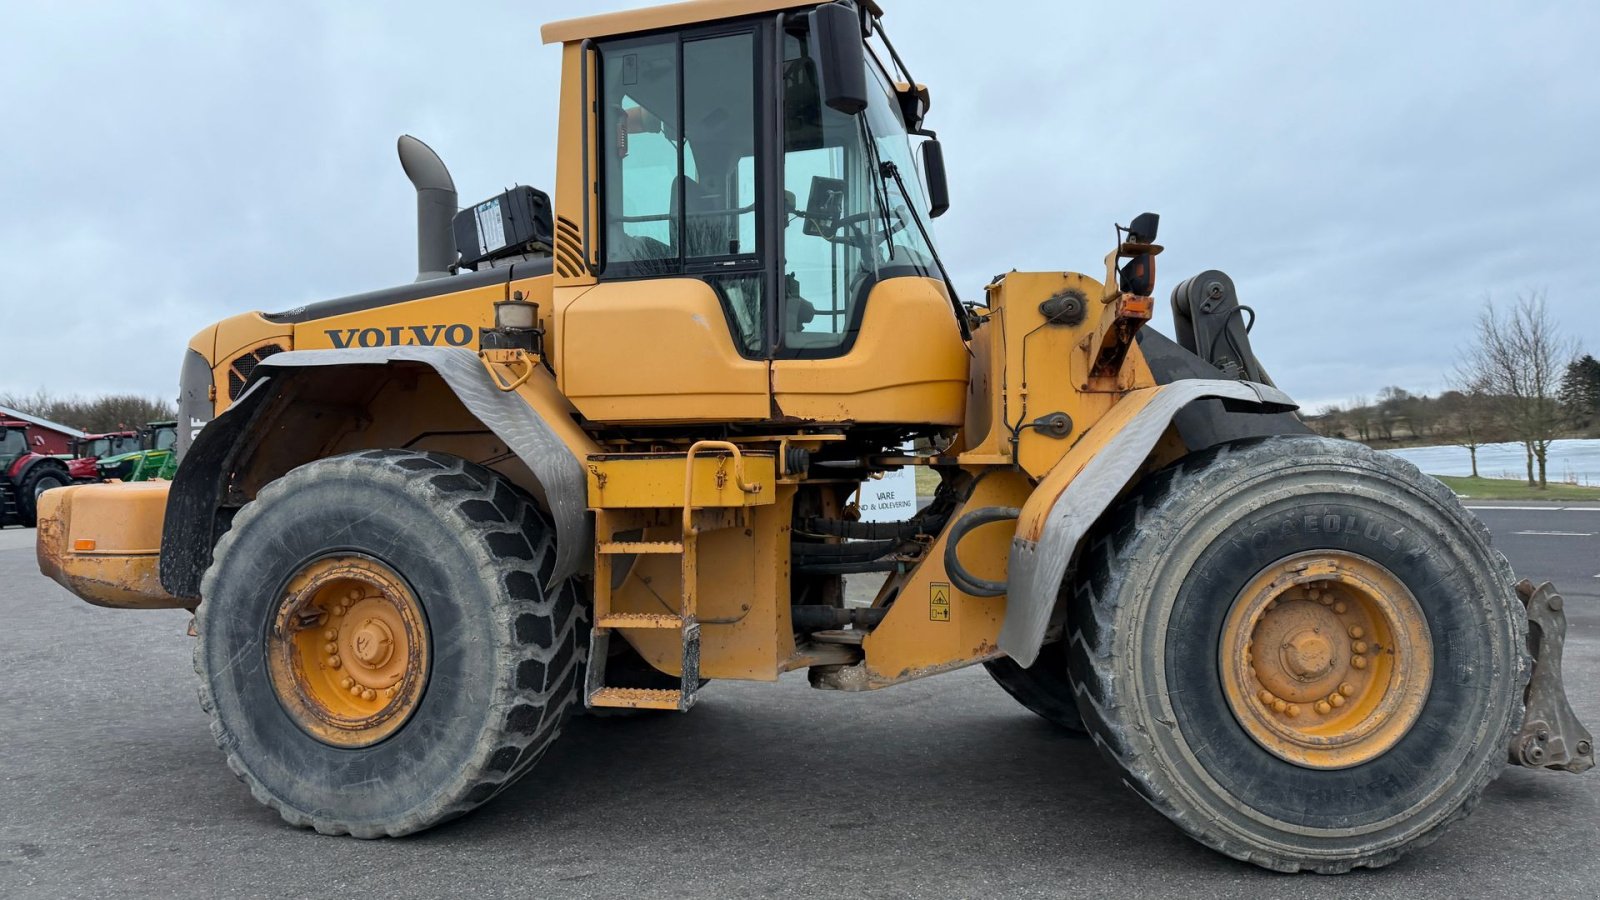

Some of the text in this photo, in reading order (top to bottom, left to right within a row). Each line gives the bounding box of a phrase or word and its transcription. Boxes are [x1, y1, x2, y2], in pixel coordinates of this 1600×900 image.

[324, 324, 473, 349] VOLVO
[876, 491, 895, 501] VARE
[870, 503, 877, 511] &
[878, 500, 911, 510] UDLEVERING
[1281, 514, 1403, 551] AEOLUS
